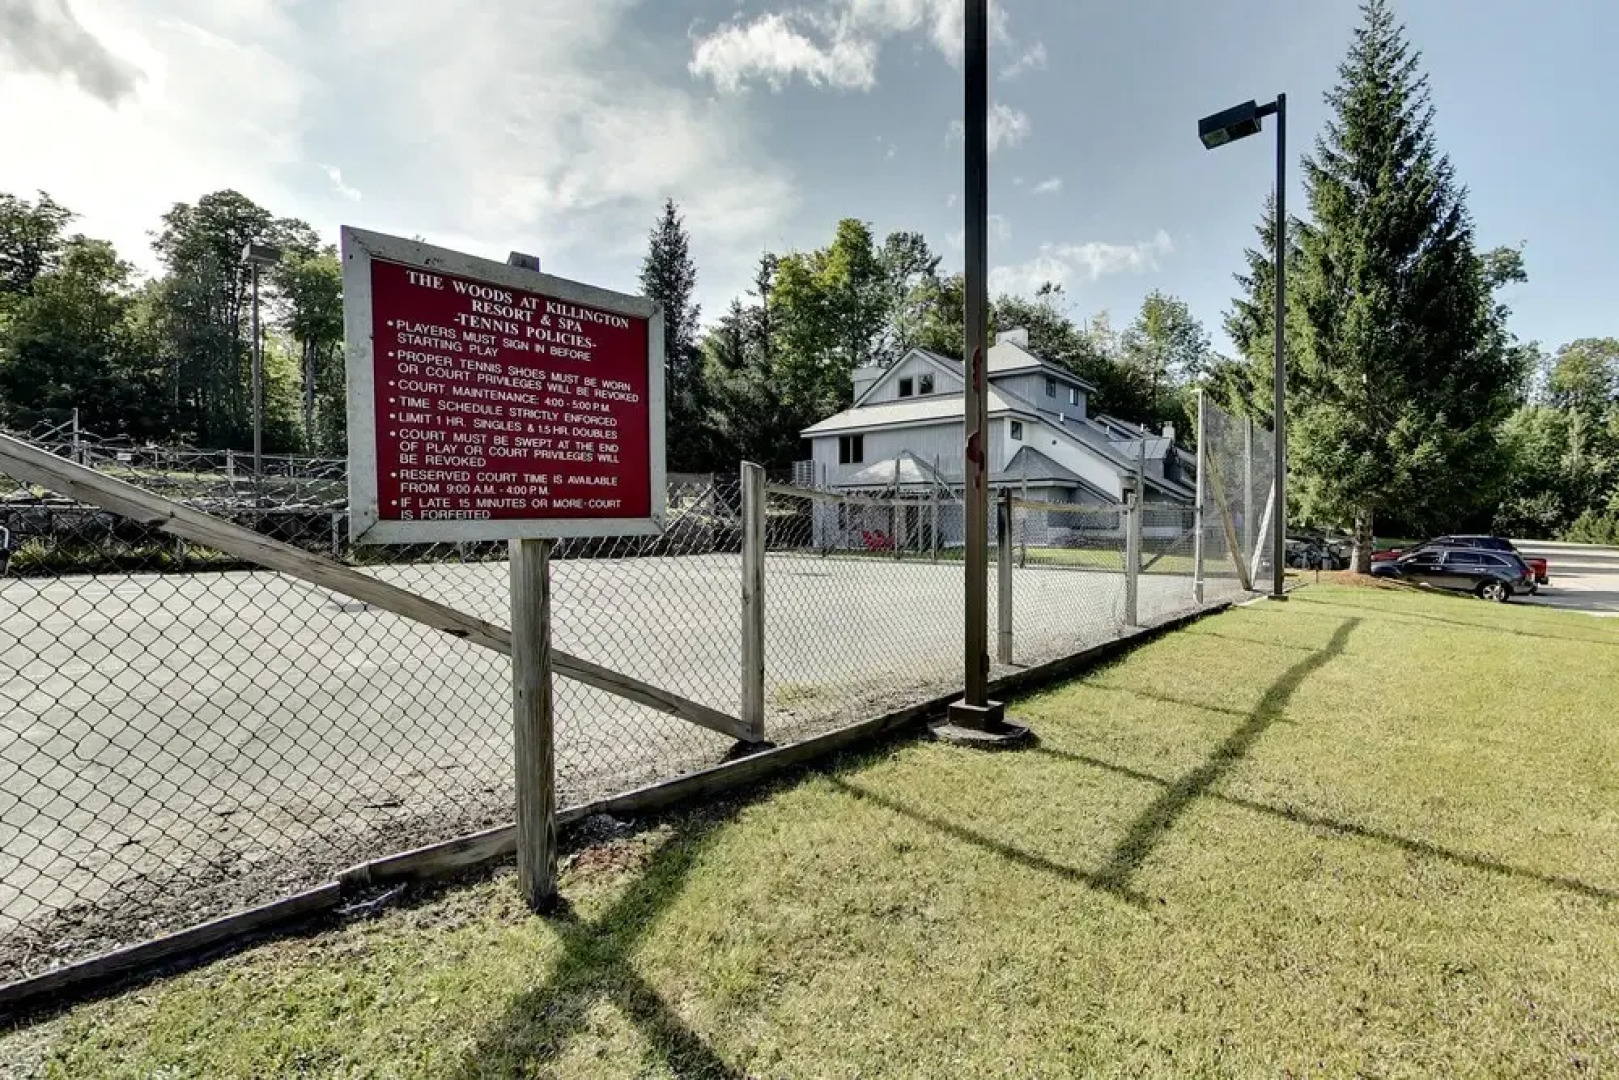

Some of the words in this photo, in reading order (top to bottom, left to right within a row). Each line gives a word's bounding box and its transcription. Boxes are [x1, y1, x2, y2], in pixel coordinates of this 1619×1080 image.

[407, 270, 444, 290] THE
[453, 281, 512, 304] WOODS
[520, 297, 539, 309] AT
[546, 302, 629, 329] KILLINGTON
[472, 299, 533, 321] RESORT
[541, 312, 551, 325] &
[558, 318, 582, 332] SPA
[396, 320, 457, 338] PLAYERS
[463, 332, 496, 344] MUST
[503, 338, 529, 350] SIGN
[534, 343, 544, 352] IN
[550, 346, 591, 361] BEFORE
[397, 334, 462, 351] STARTING
[469, 344, 499, 356] PLAY
[397, 350, 452, 366] PROPER
[460, 359, 502, 373] TENNIS
[508, 366, 546, 379] SHOES
[551, 373, 579, 384] MUST
[584, 378, 597, 387] BE
[602, 380, 631, 391] WORN
[398, 364, 418, 374] OR
[425, 366, 470, 381] COURT
[477, 374, 543, 390] PRIVILEGES
[547, 382, 571, 394] WILL
[576, 387, 589, 396] BE
[594, 389, 638, 402] REVOKED
[398, 380, 445, 394] COURT
[544, 398, 564, 408] 4:00
[573, 400, 591, 411] 5:00
[400, 397, 430, 408] TIME
[438, 401, 502, 415] SCHEDULE
[509, 408, 559, 420] STRICTLY
[565, 413, 617, 426] ENFORCED
[398, 413, 431, 424] LIMIT
[437, 416, 441, 425] 1
[474, 418, 521, 431] SINGLES
[528, 424, 534, 433] &
[573, 427, 617, 439] DOUBLES
[400, 429, 447, 441] COURT
[453, 432, 487, 444] MUST
[494, 436, 508, 446] BE
[515, 438, 552, 448] SWEPT
[558, 440, 570, 449] AT
[576, 442, 594, 451] THE
[599, 443, 618, 452] END
[400, 442, 418, 452] OF
[426, 444, 458, 455] PLAY
[465, 445, 483, 455] OR
[489, 447, 528, 457] COURT
[534, 450, 593, 462] PRIVILEGES
[598, 454, 619, 463] WILL
[400, 454, 417, 464] BE
[426, 455, 486, 467] REVOKED
[400, 470, 470, 482] RESERVED
[476, 473, 518, 482] COURT
[524, 474, 547, 483] TIME
[554, 475, 562, 484] IS
[568, 476, 617, 486] AVAILABLE
[400, 483, 439, 493] FROM
[447, 485, 470, 494] 9:00
[506, 486, 528, 495] 4:00
[401, 498, 412, 508] IF
[419, 498, 450, 508] LATE
[458, 499, 470, 508] 15
[476, 499, 526, 508] MINUTES
[531, 499, 547, 508] OR
[401, 510, 413, 520] IS
